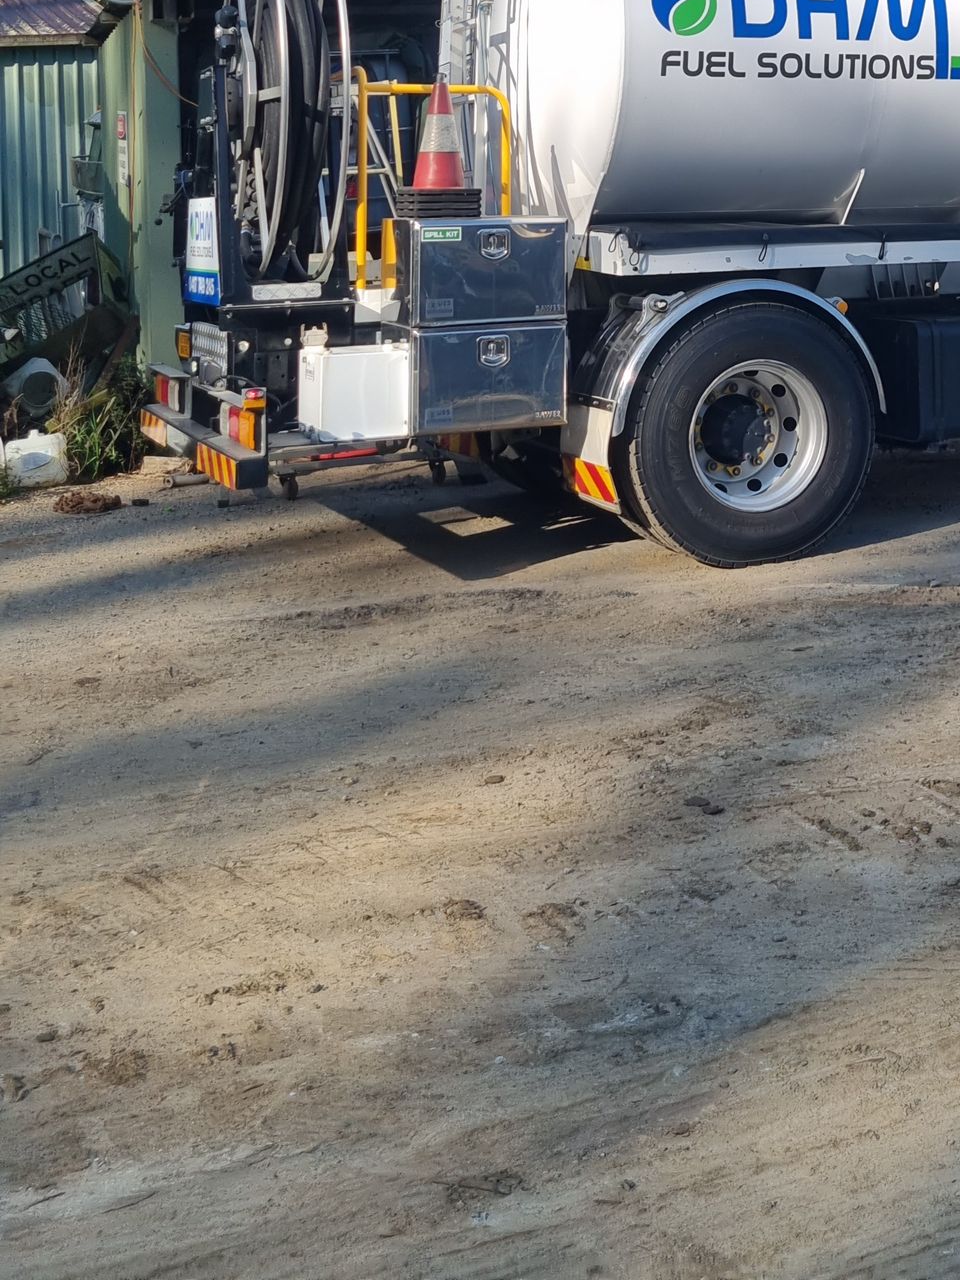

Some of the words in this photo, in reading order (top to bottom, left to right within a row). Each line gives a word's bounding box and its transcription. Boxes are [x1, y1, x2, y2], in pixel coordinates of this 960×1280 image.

[660, 50, 746, 78] FUEL
[757, 52, 935, 80] SOLUTIONS
[445, 230, 459, 238] KIT
[8, 251, 92, 296] LOCAL
